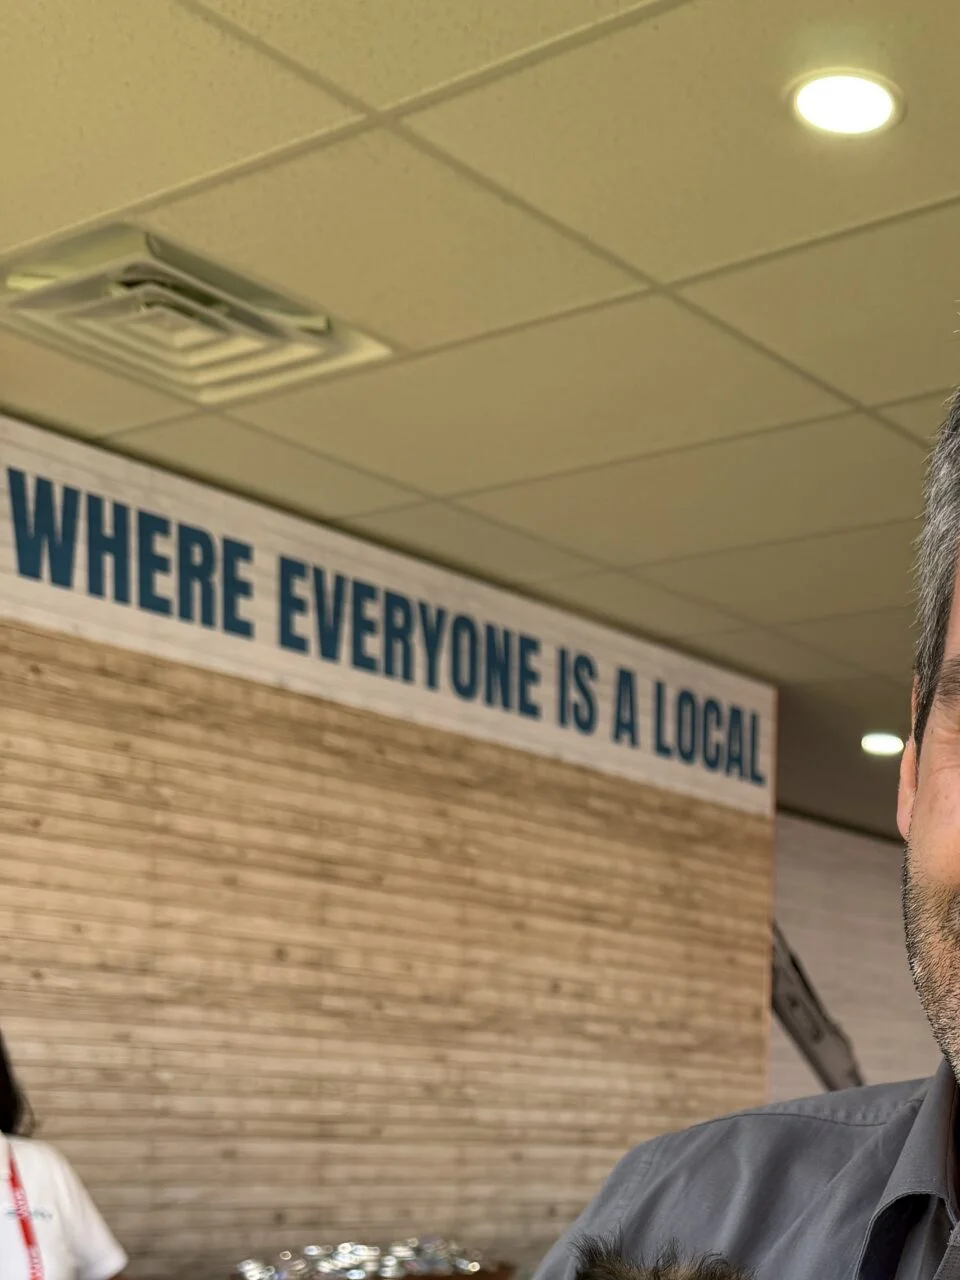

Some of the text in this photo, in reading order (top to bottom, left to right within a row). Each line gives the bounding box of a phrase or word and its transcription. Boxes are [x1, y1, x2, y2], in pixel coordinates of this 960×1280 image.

[7, 466, 765, 787] WHERE EVERYONE IS A LOCAL
